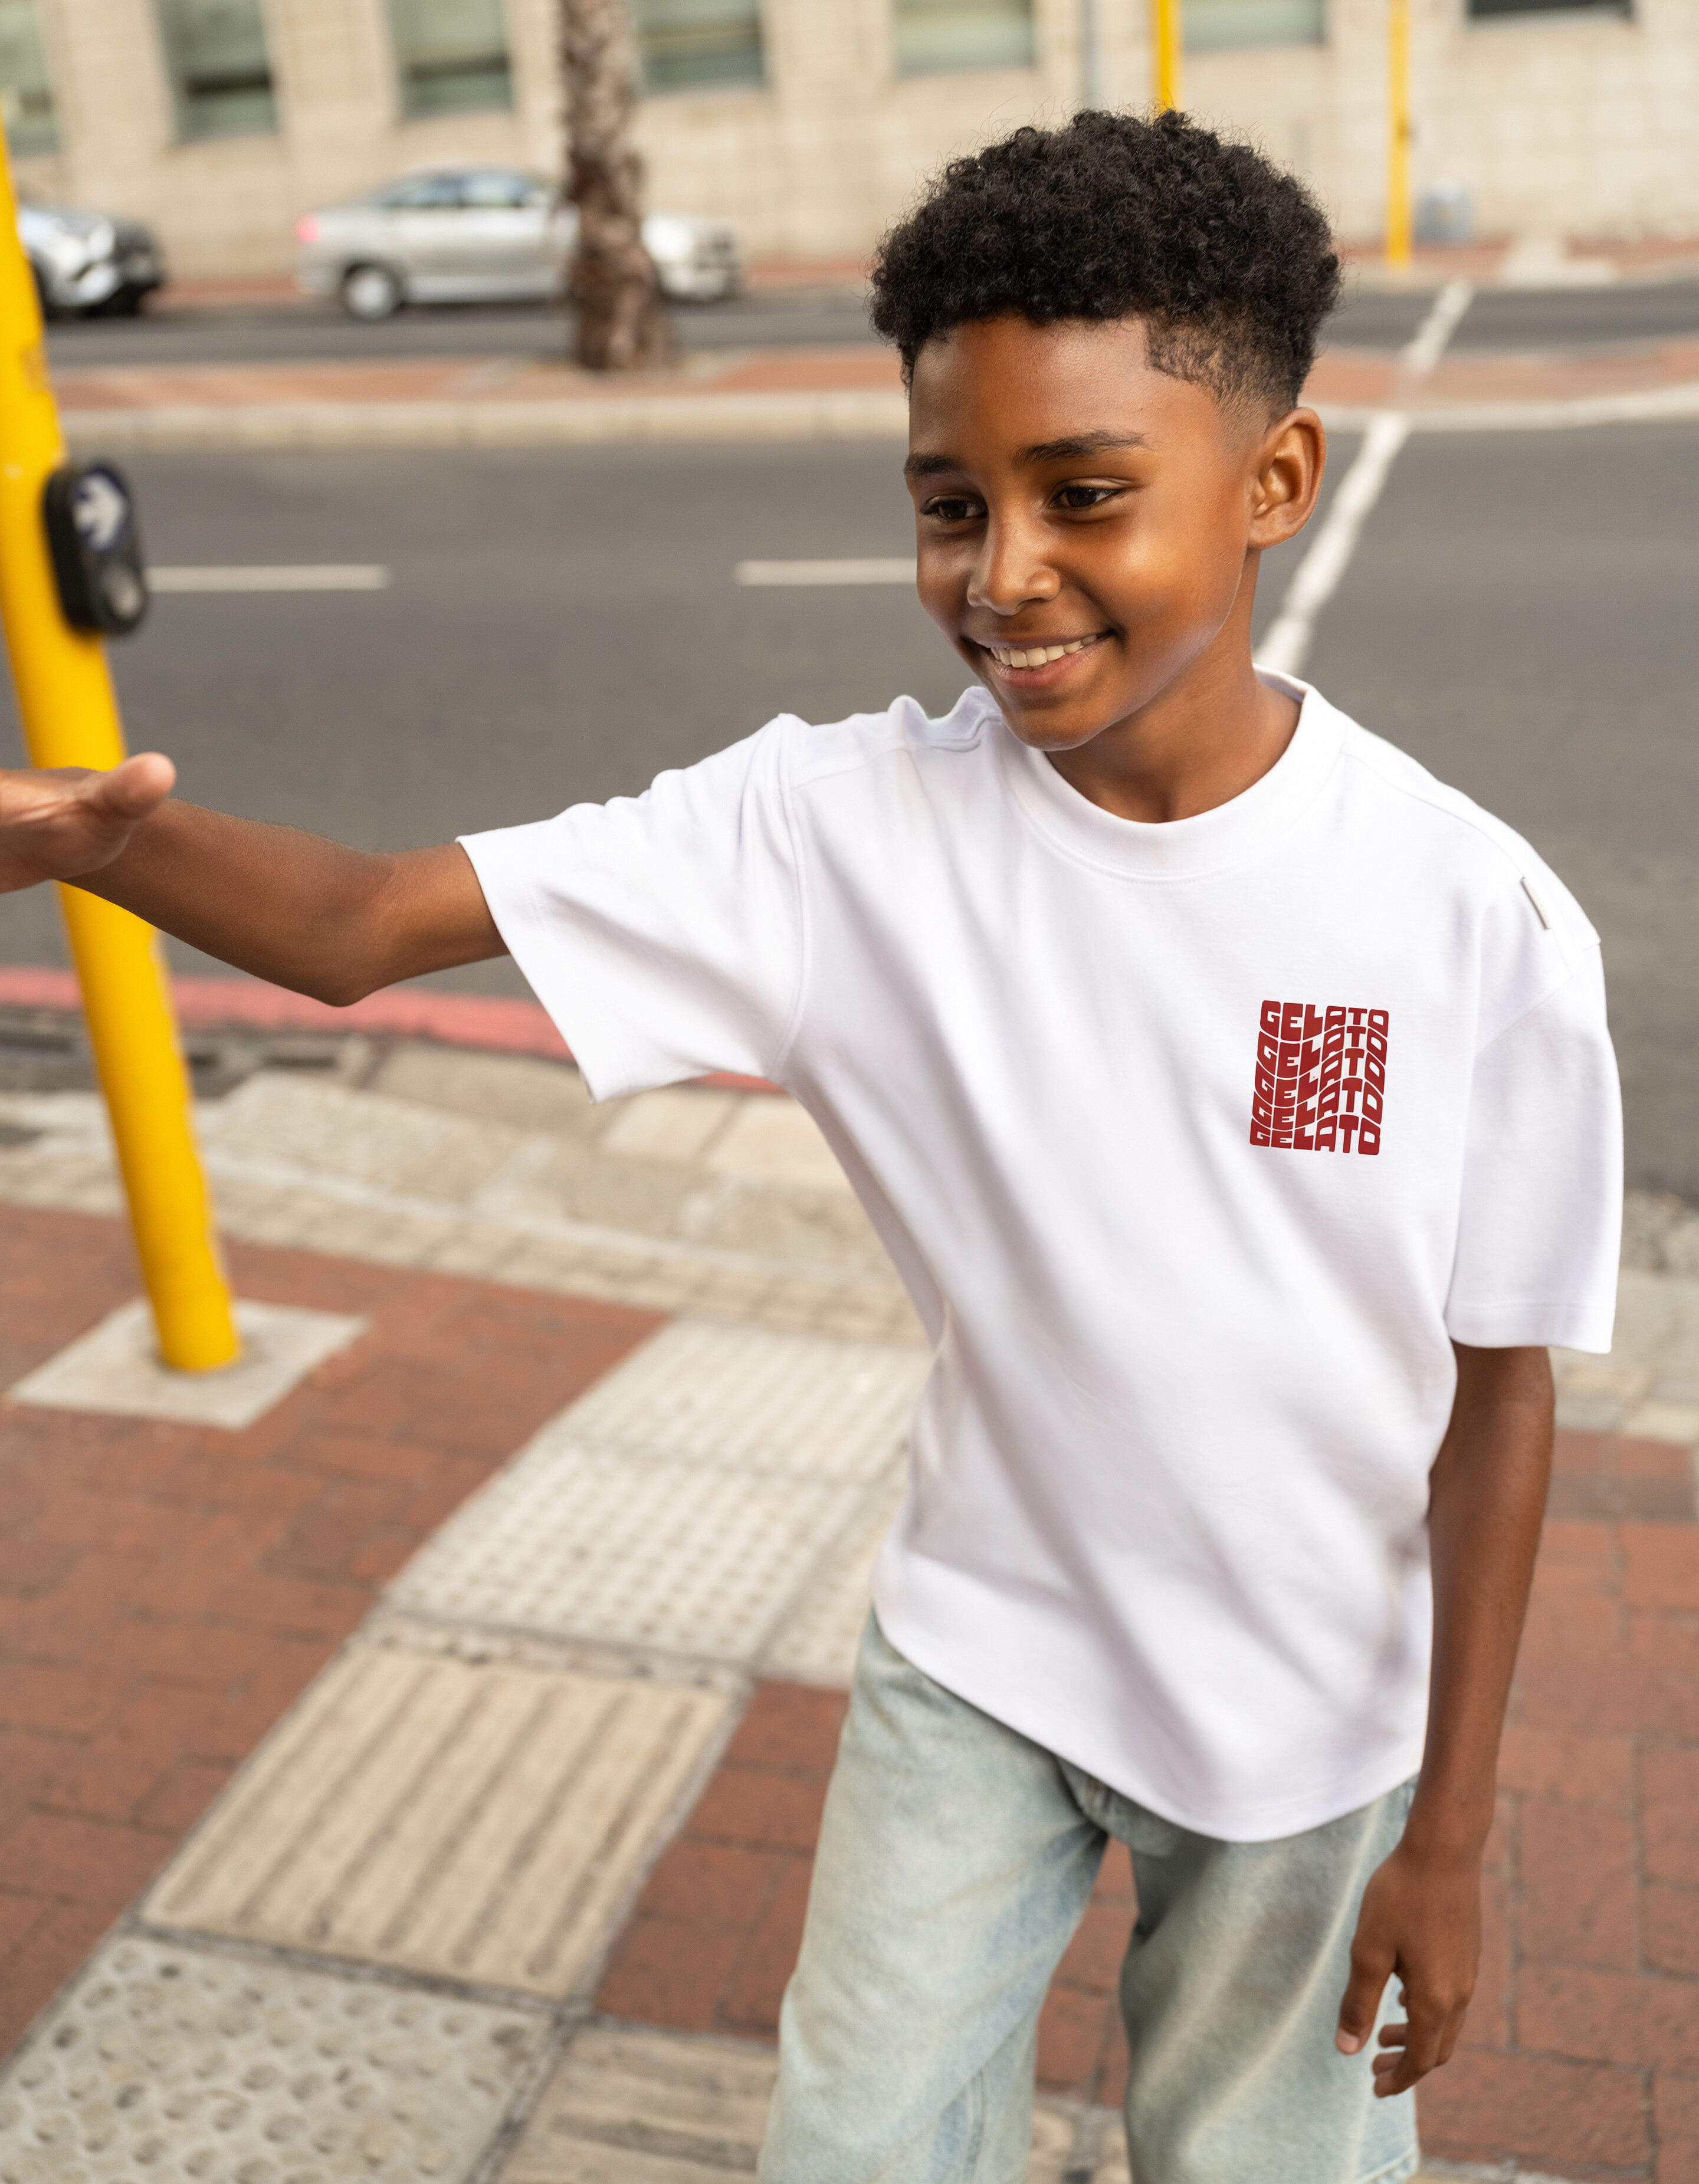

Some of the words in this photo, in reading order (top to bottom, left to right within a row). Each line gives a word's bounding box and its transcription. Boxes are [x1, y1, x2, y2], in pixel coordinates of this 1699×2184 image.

[1260, 1000, 1389, 1042] GELATO
[1255, 1048, 1385, 1107] GELATO
[1257, 1026, 1388, 1078] GELATO
[1252, 1077, 1383, 1131] GELATO
[1249, 1114, 1380, 1155] GELATO
